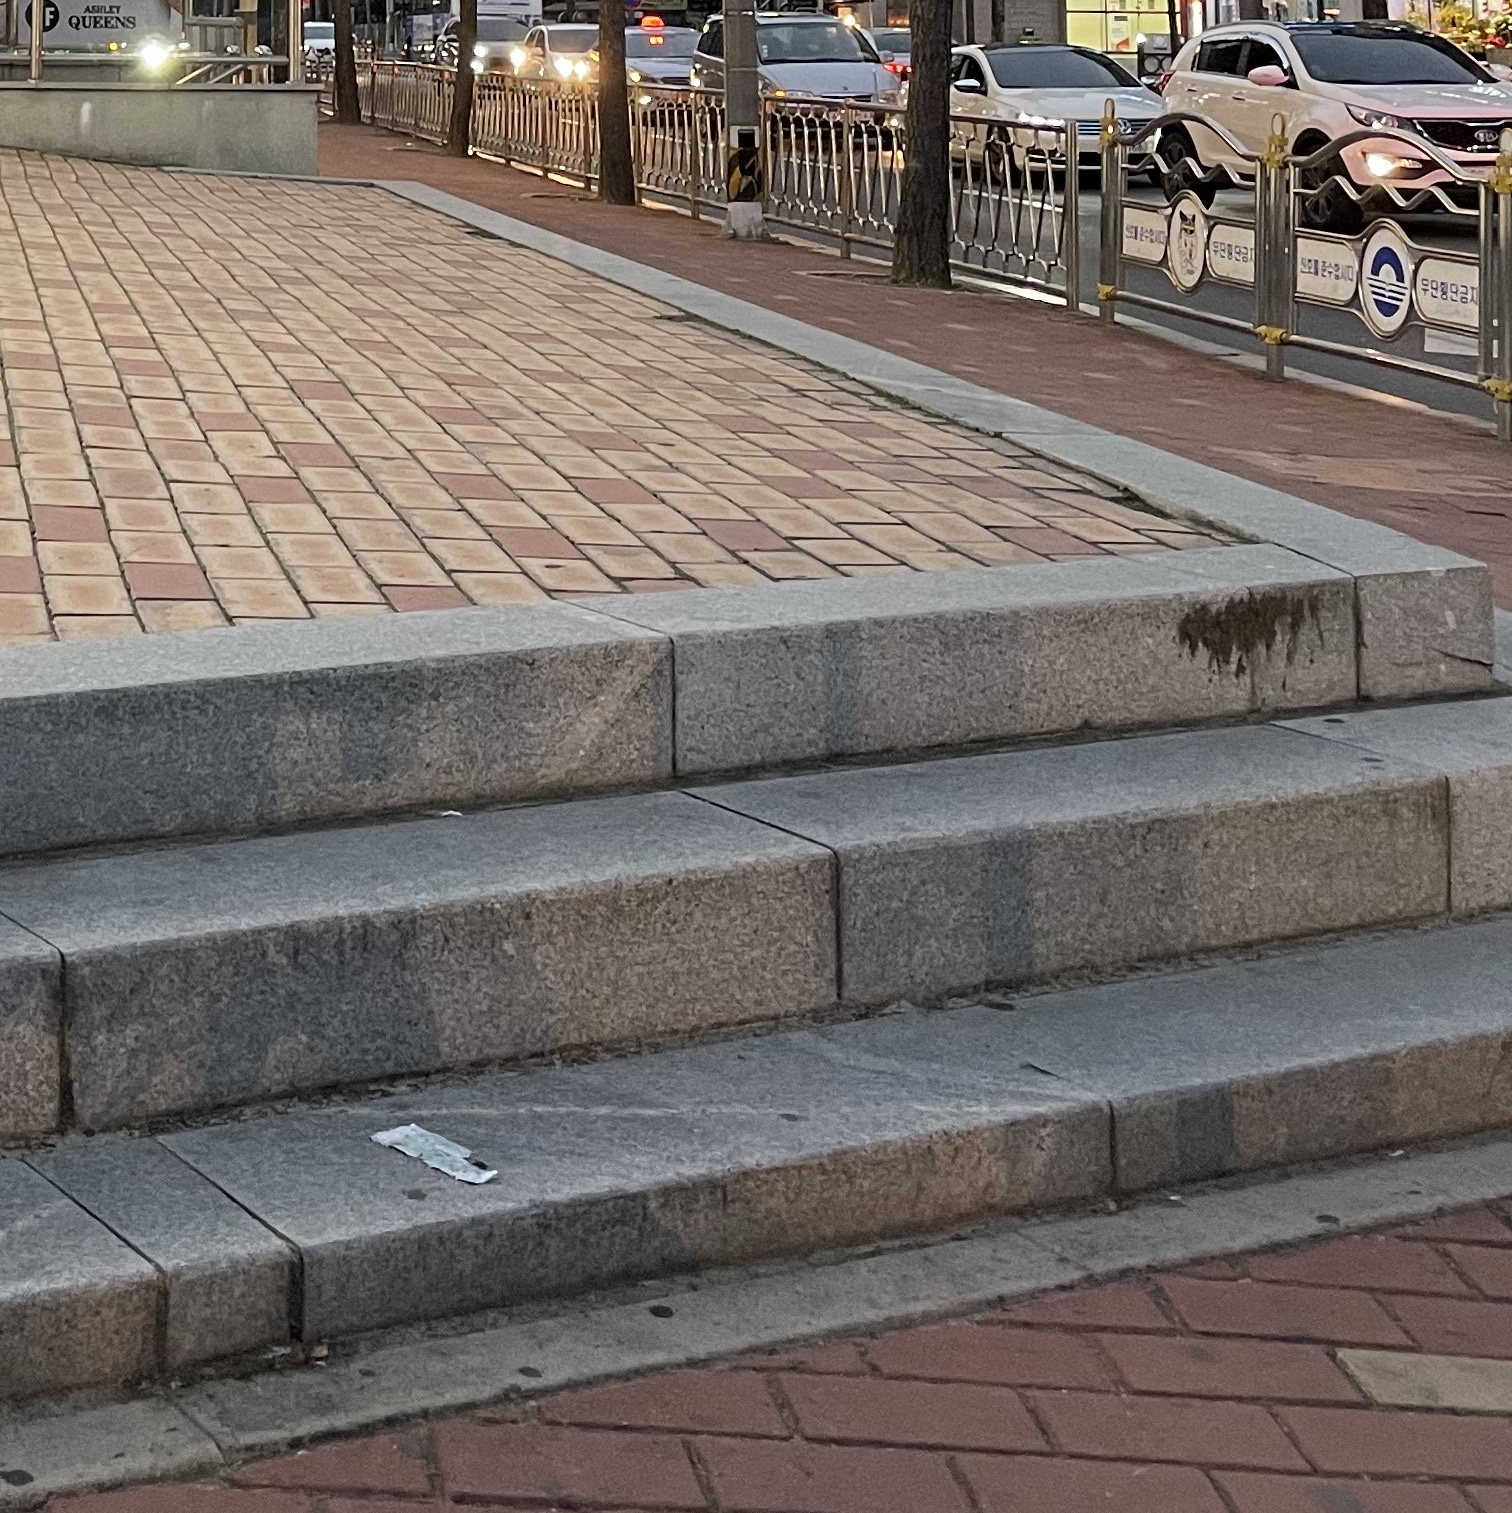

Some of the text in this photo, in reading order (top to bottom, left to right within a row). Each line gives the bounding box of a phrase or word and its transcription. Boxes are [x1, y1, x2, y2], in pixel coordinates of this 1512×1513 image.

[82, 4, 122, 15] ASHLEY
[68, 15, 137, 31] QUEENS
[1321, 258, 1355, 283] 준수합시다
